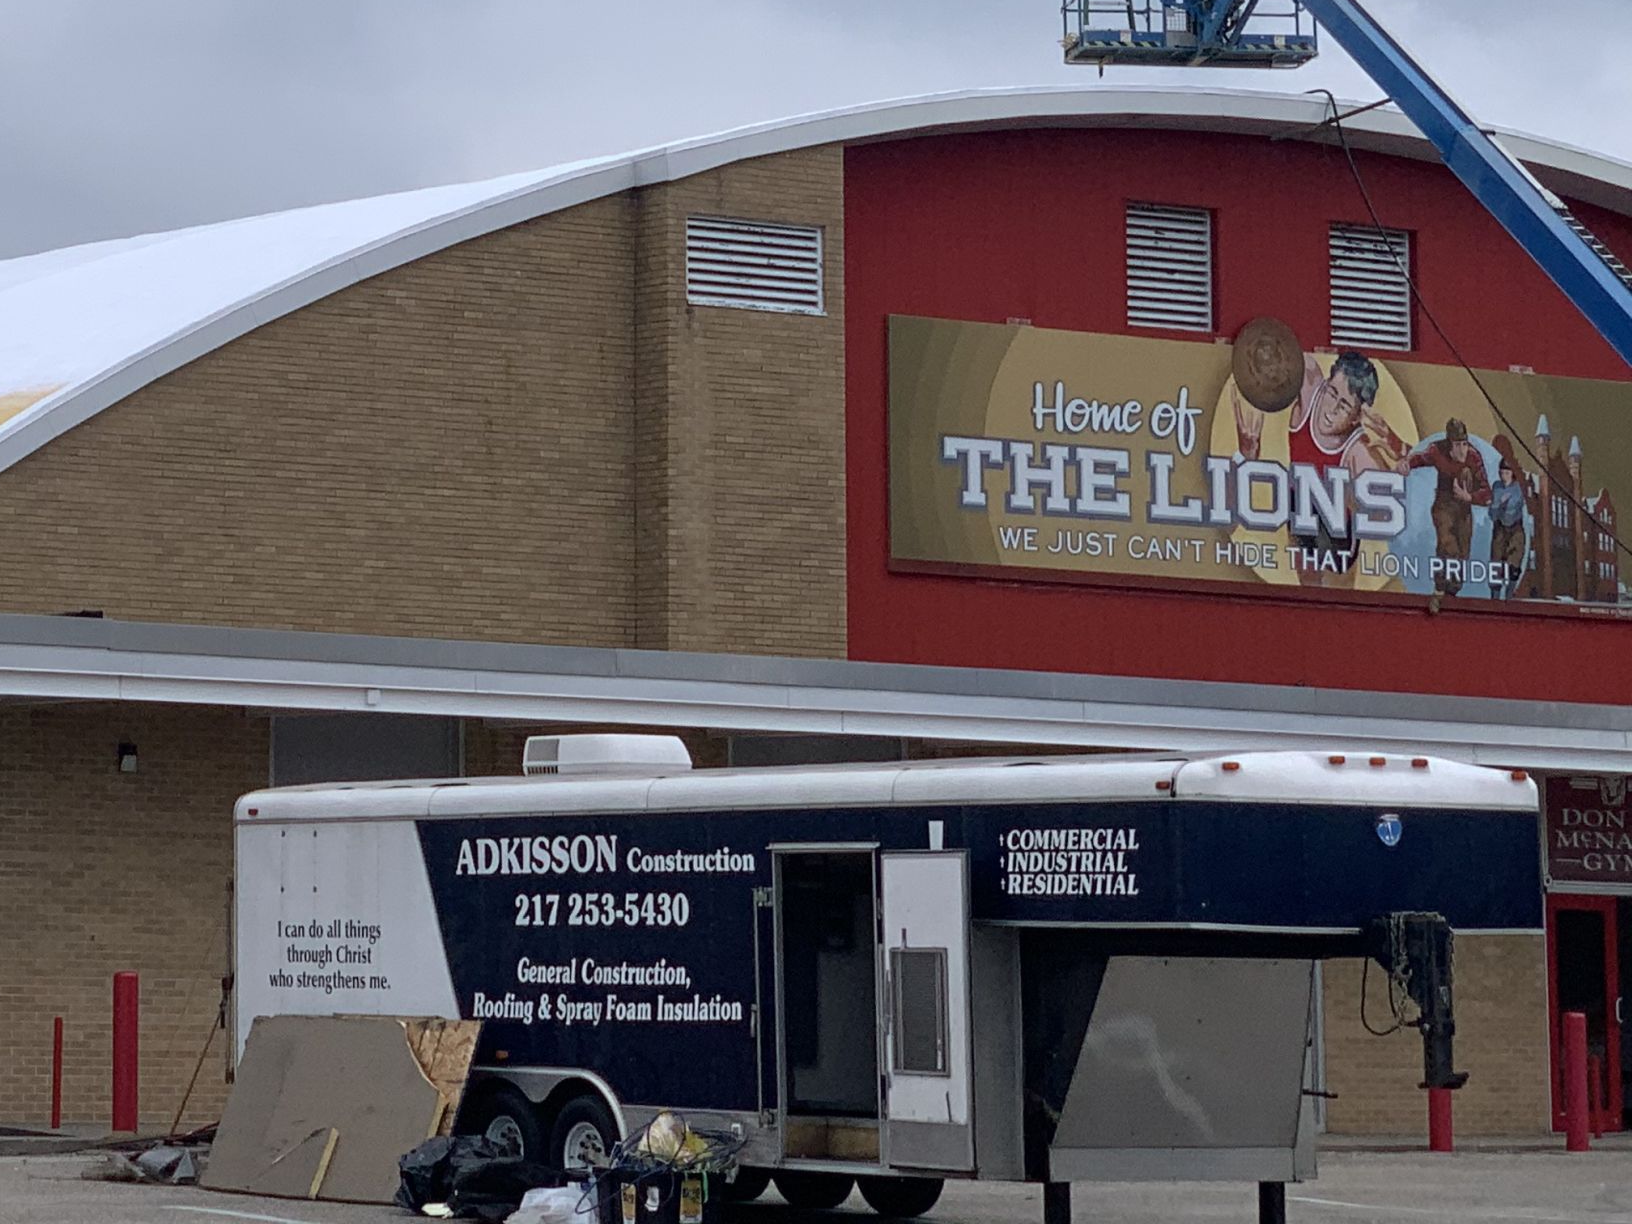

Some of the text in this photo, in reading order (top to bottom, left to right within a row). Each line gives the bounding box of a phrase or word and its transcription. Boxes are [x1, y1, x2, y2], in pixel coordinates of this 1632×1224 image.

[1033, 381, 1203, 456] Home of
[942, 435, 1406, 538] THE LIONS
[999, 526, 1510, 585] WE JUST CAN'T HIDE THAT LION PRIDE!
[1562, 807, 1625, 829] DON
[1006, 829, 1139, 850] COMMERCIAL
[456, 835, 755, 875] ADKISSON Construction
[1007, 851, 1128, 872] INDUSTRIAL
[1007, 873, 1139, 896] RESIDENTIAL
[515, 892, 690, 926] 217 253-5430
[277, 919, 381, 945] I can do all things
[287, 944, 372, 969] through Christ
[269, 968, 391, 995] who strengthens me.
[518, 956, 691, 989] General Construction,
[473, 992, 742, 1025] Roofing & Spray Foam Insulation
